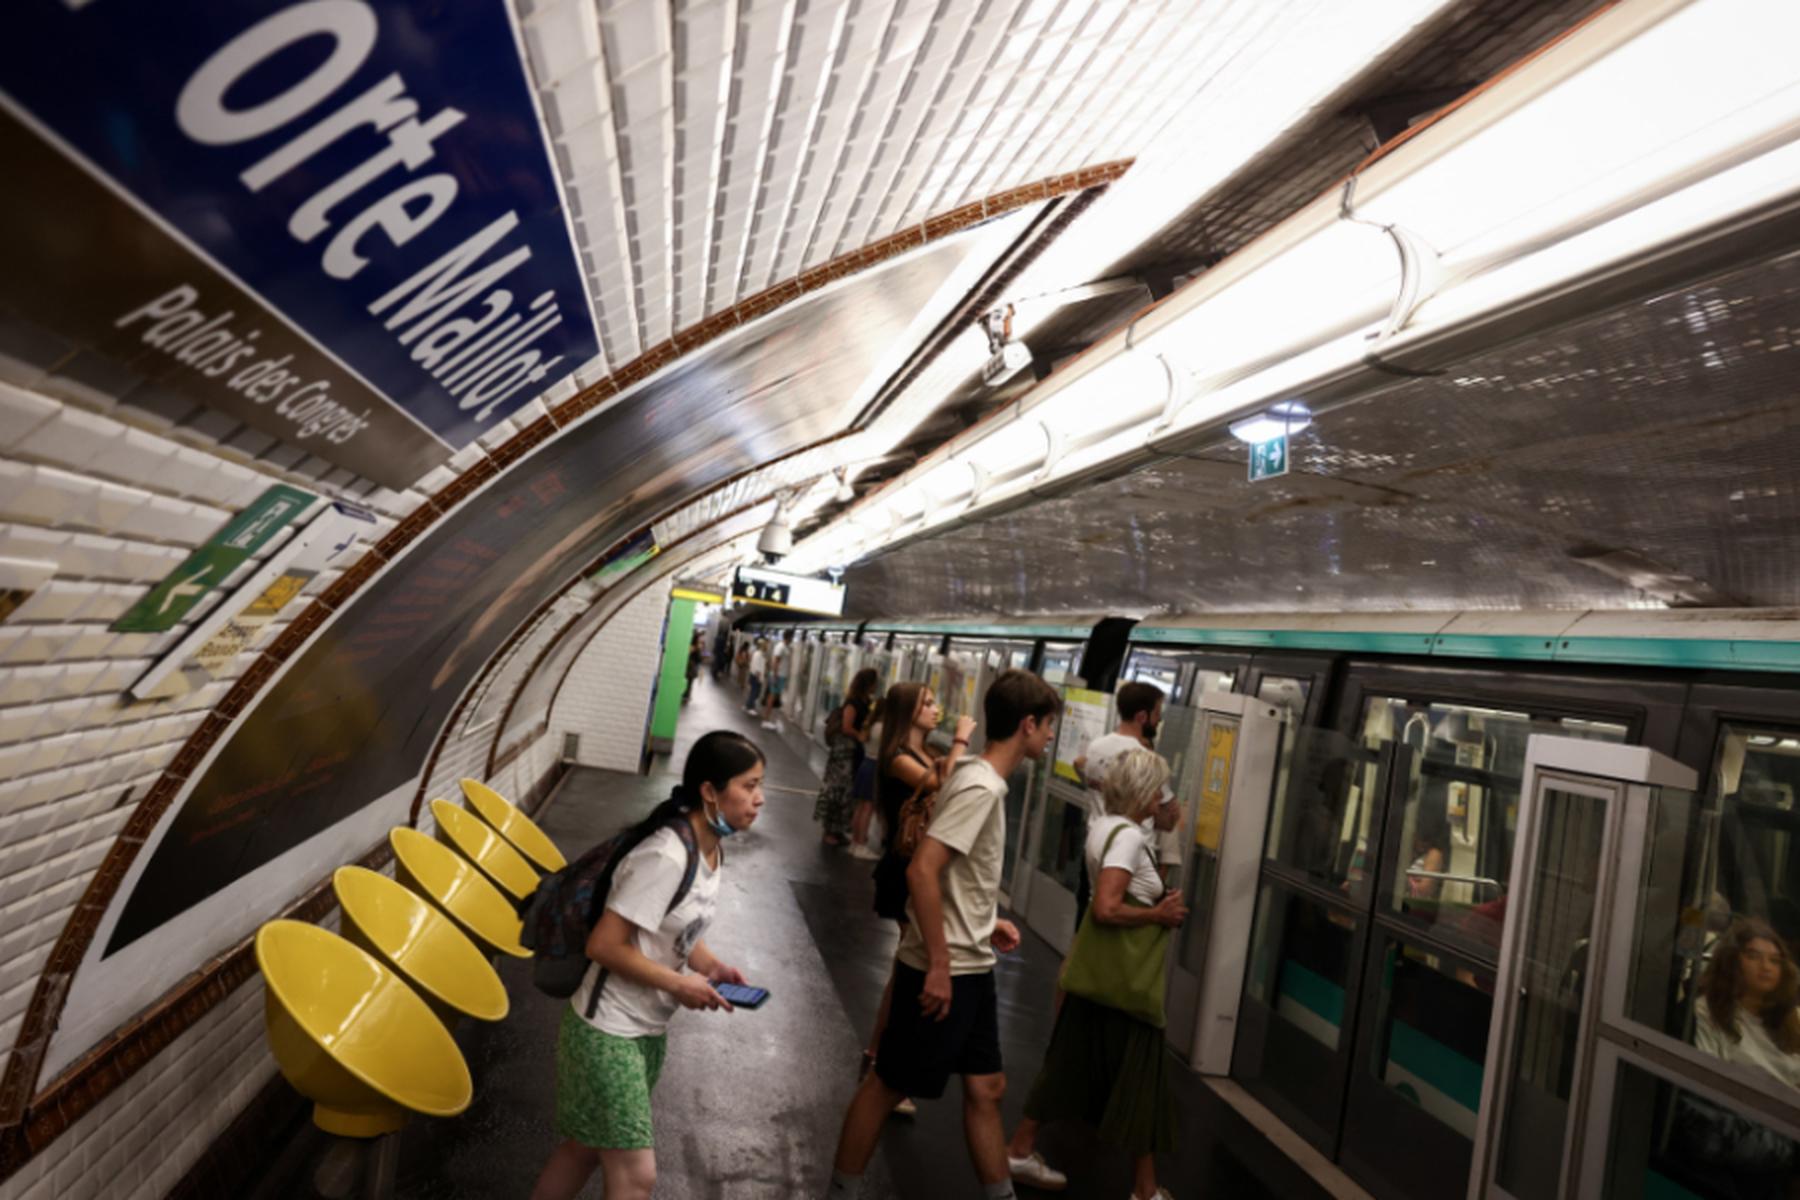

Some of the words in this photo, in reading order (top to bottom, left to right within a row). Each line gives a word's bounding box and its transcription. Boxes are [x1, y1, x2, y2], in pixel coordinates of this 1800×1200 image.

[61, 0, 467, 280] orte
[366, 209, 565, 423] Maillot
[114, 284, 261, 378] Palais
[227, 354, 300, 404] des
[275, 380, 372, 445] Congrès
